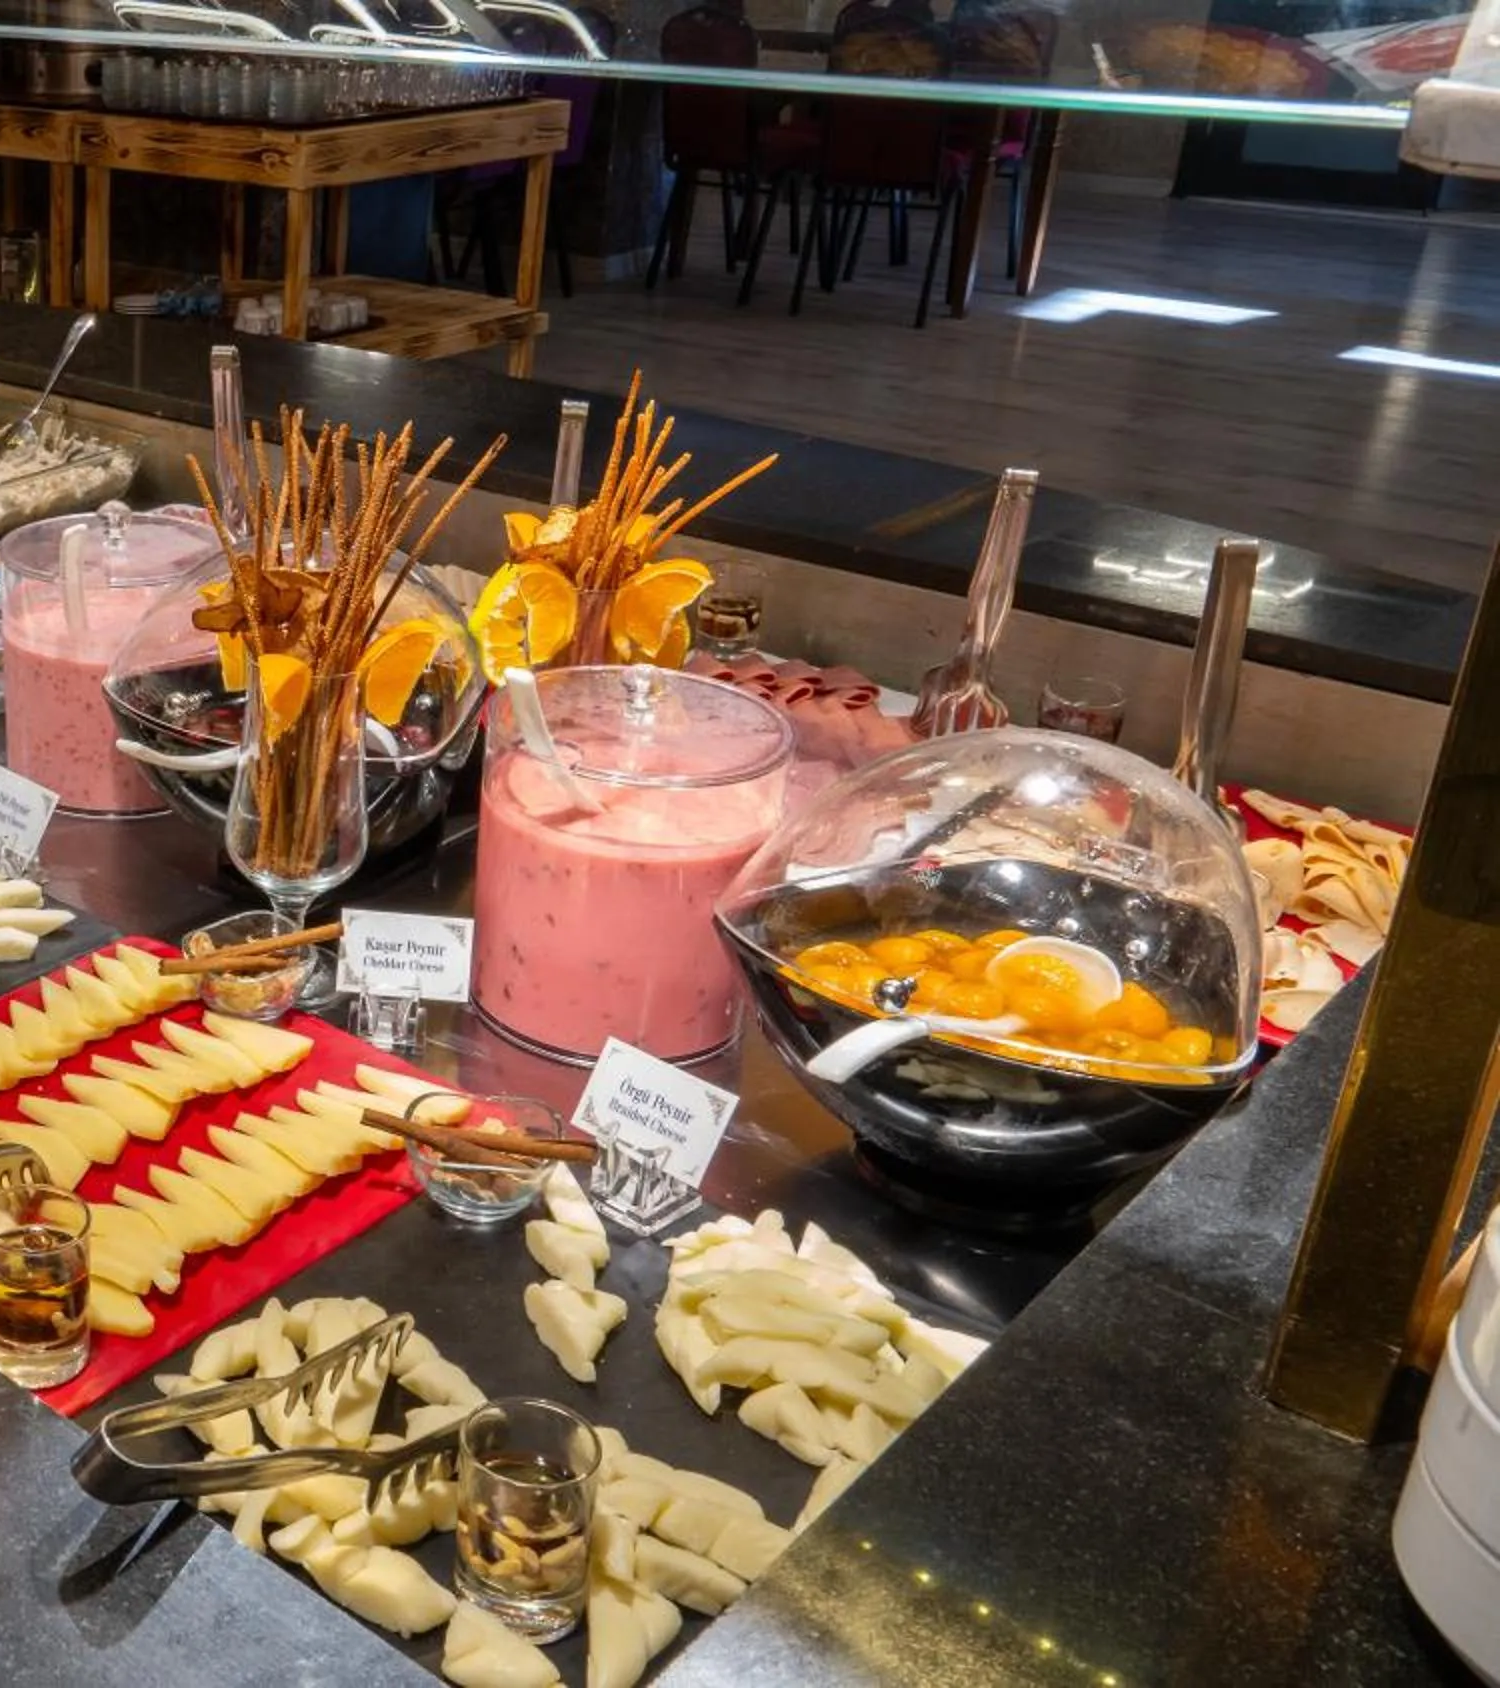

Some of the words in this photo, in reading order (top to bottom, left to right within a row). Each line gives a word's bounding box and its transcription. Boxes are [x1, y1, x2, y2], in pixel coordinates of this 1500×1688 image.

[365, 936, 402, 954] Kaşar
[406, 940, 447, 957] Peynir
[363, 955, 406, 970] Cheddar
[409, 961, 445, 973] Cheese
[619, 1075, 651, 1104] Örgü
[653, 1094, 694, 1125] Peynir
[608, 1097, 651, 1126] Braided
[650, 1118, 687, 1144] Cheese
